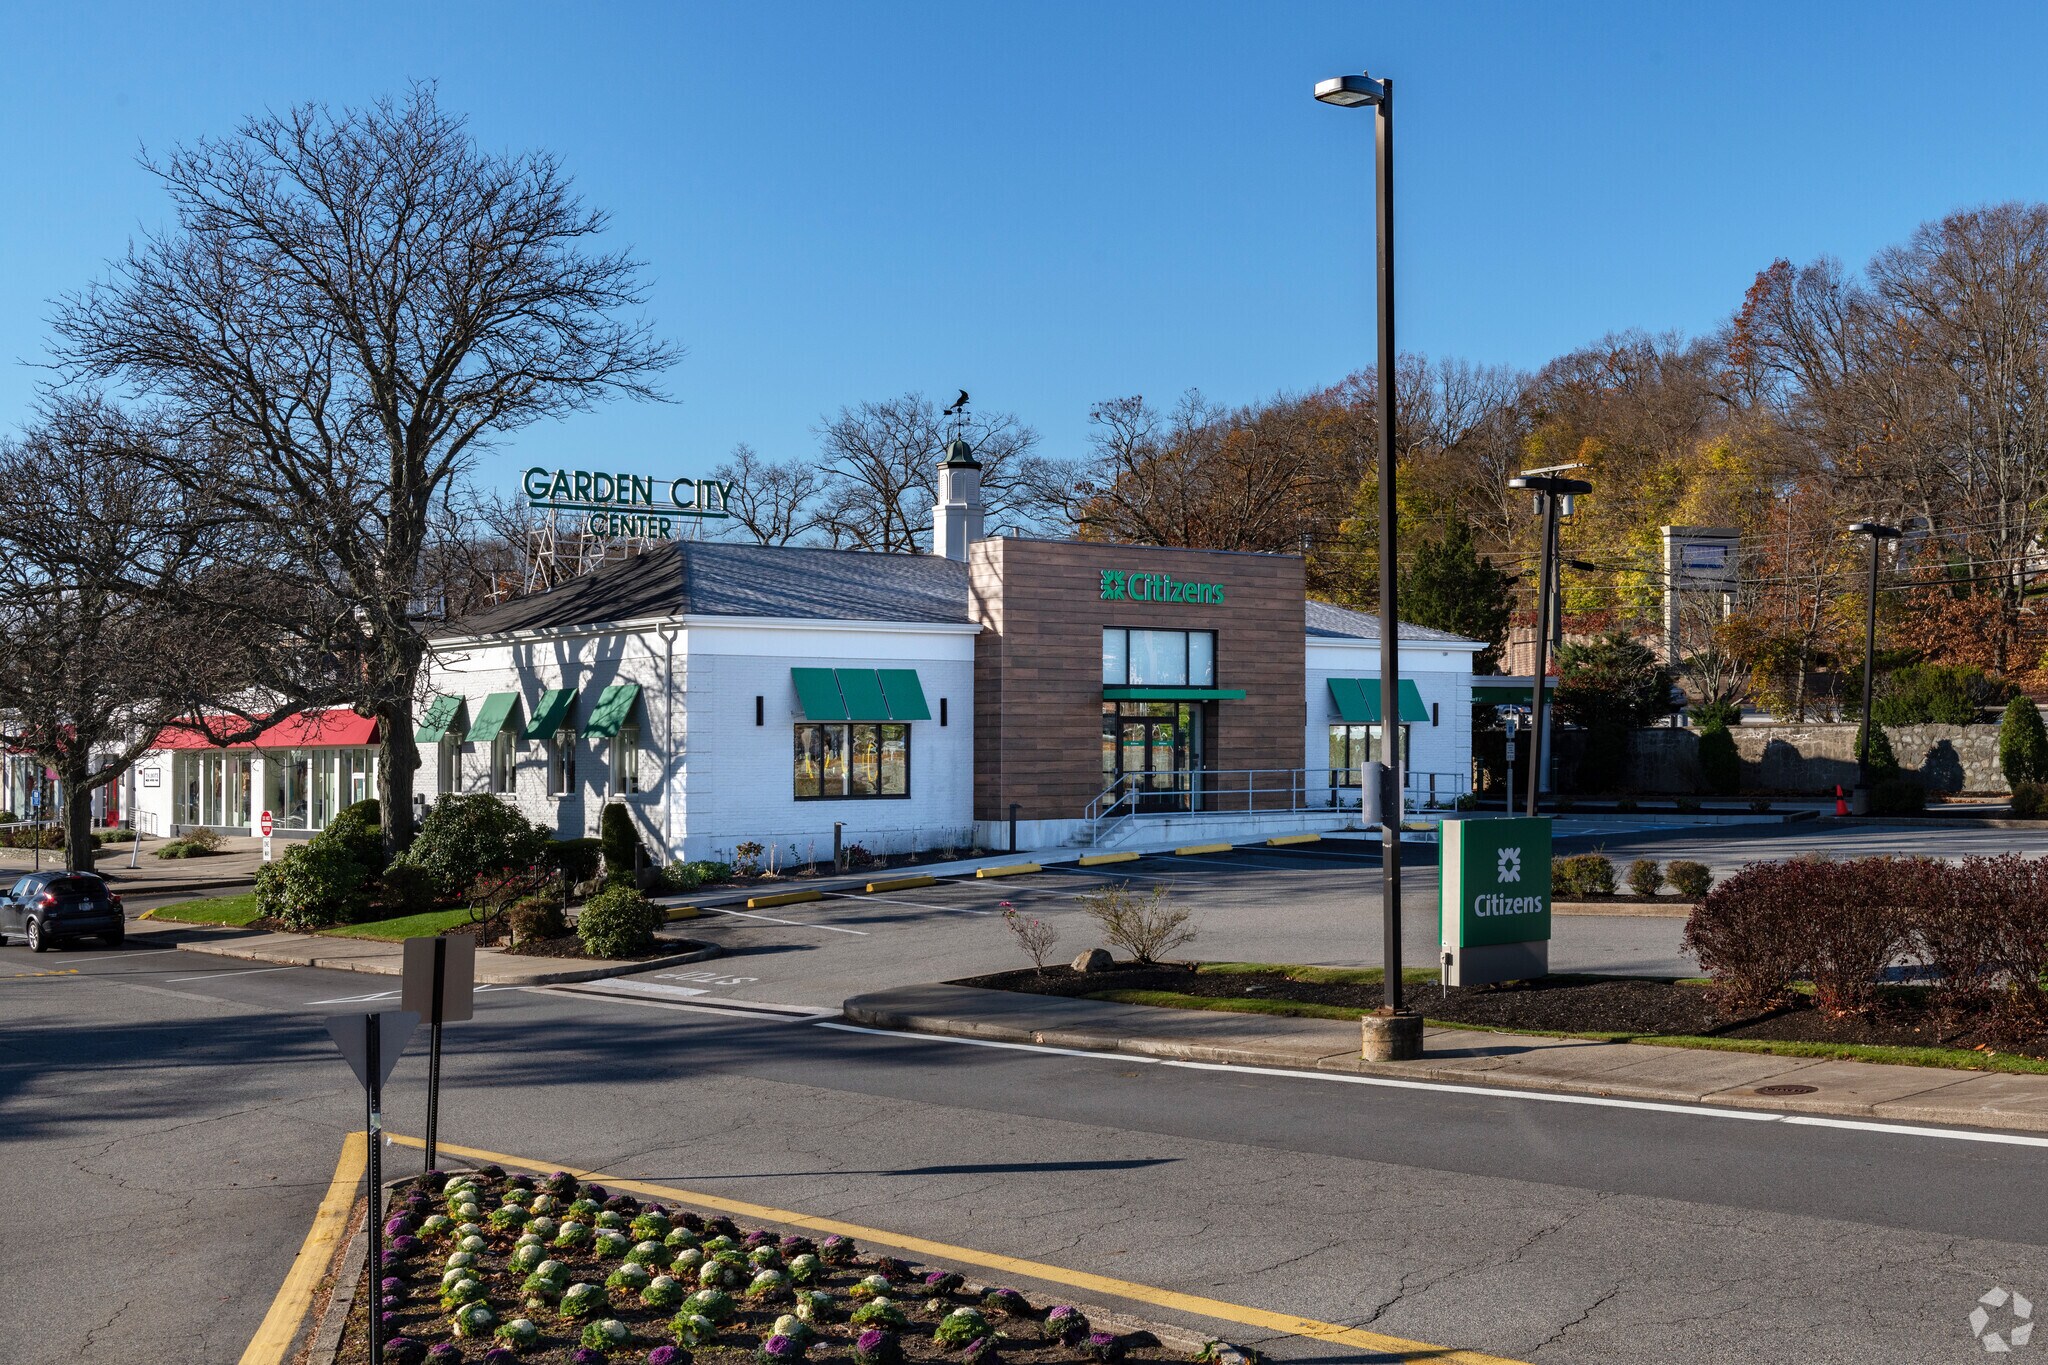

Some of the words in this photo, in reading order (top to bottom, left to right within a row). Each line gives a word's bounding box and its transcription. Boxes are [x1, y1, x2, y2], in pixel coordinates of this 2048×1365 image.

[522, 467, 652, 505] GARDEN
[669, 477, 734, 511] CITY
[588, 513, 672, 539] CENTER
[1128, 573, 1225, 604] Citizens
[1474, 893, 1542, 917] Citizens
[654, 971, 759, 985] STOP
